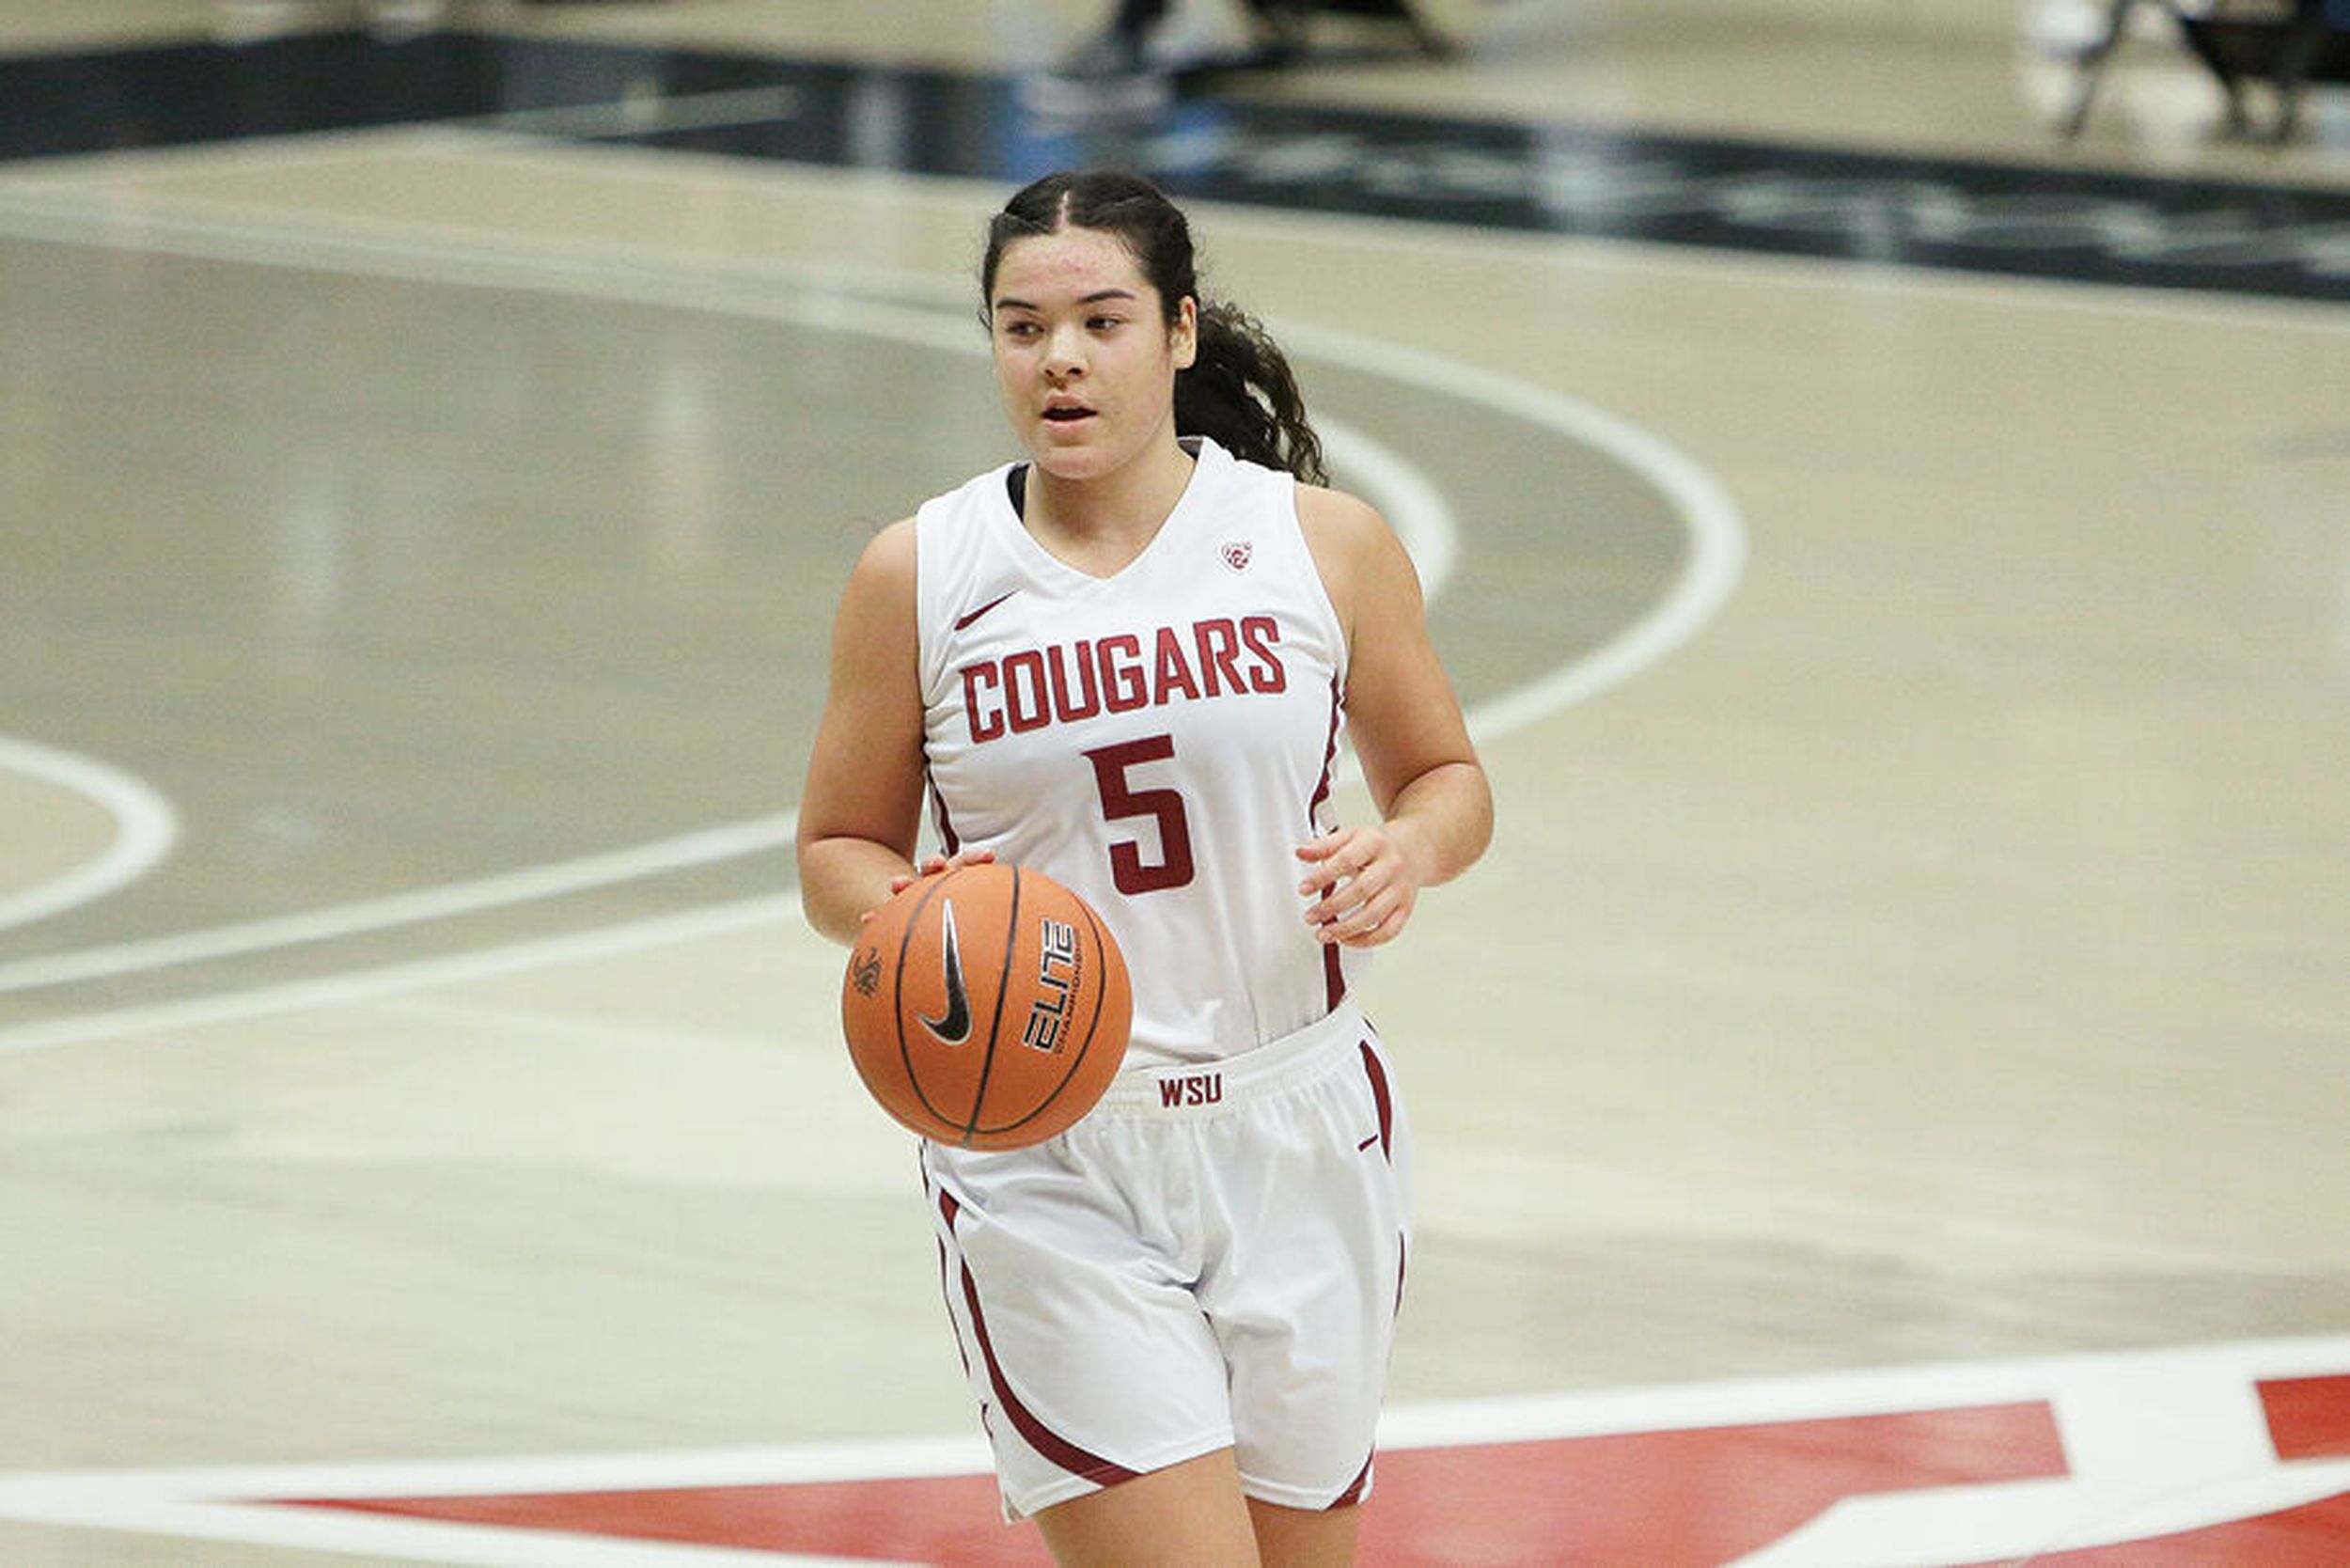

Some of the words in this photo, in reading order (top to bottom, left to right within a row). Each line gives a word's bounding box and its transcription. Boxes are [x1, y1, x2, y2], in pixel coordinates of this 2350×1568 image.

[959, 616, 1287, 744] COUGARS
[1081, 733, 1195, 896] 5
[1023, 919, 1073, 1051] ELITE
[1158, 1073, 1222, 1107] WSU
